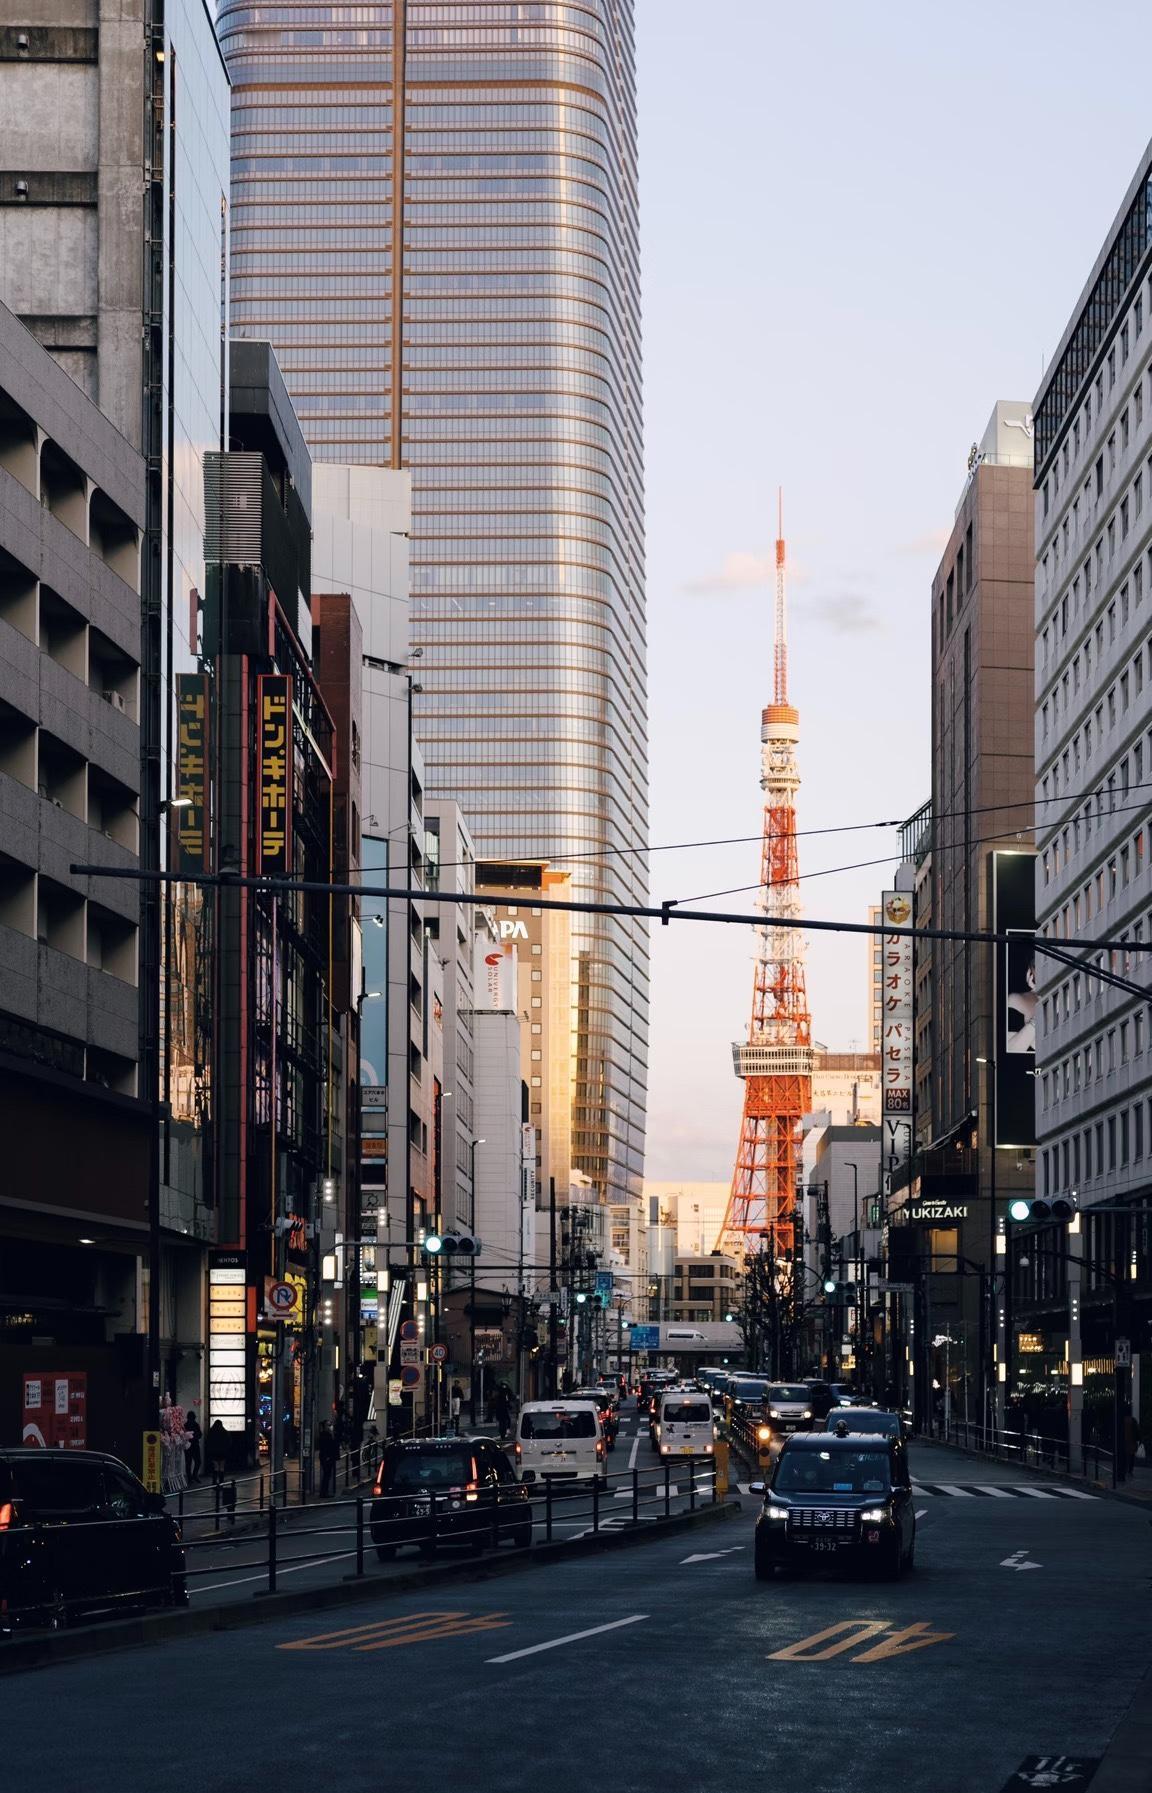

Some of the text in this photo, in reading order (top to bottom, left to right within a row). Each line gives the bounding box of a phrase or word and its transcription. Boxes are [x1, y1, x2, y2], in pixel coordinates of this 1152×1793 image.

[885, 1024, 902, 1084] パセラ
[903, 1026, 911, 1082] PASELA
[887, 1089, 908, 1098] MAX
[903, 1206, 968, 1219] YUKIZAKI
[434, 1348, 445, 1357] 40
[766, 1620, 956, 1663] 40
